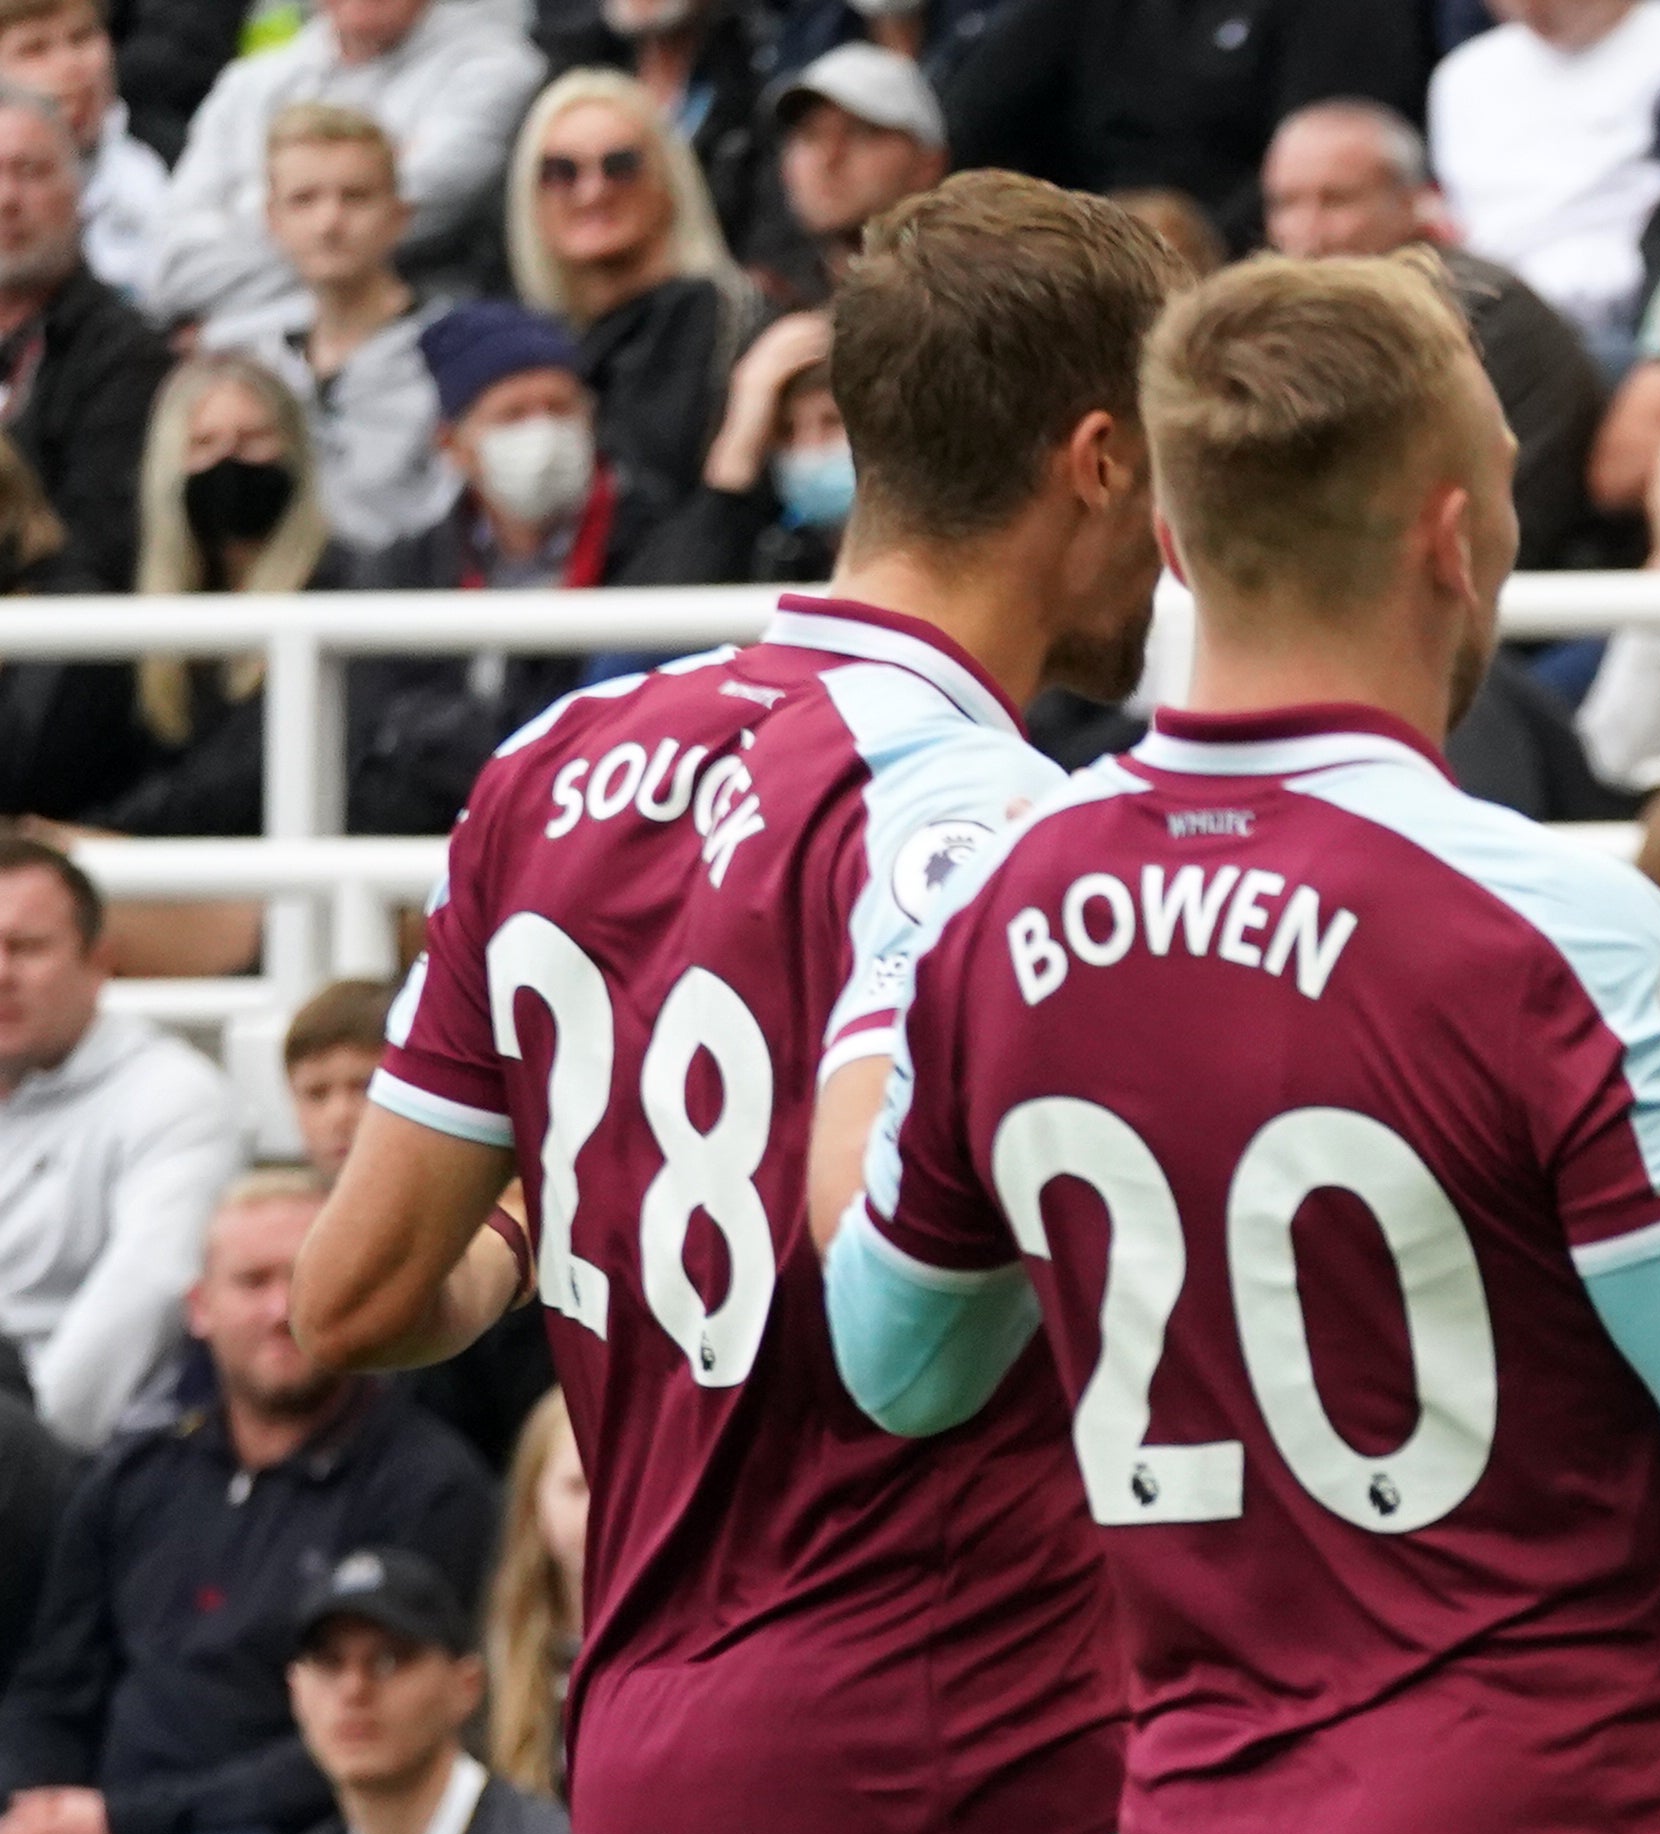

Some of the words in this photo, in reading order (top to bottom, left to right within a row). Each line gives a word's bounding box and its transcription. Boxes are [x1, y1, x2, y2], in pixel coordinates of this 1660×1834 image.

[486, 911, 775, 1388] 28
[1006, 864, 1358, 1006] BOWEN
[992, 1095, 1498, 1534] 20
